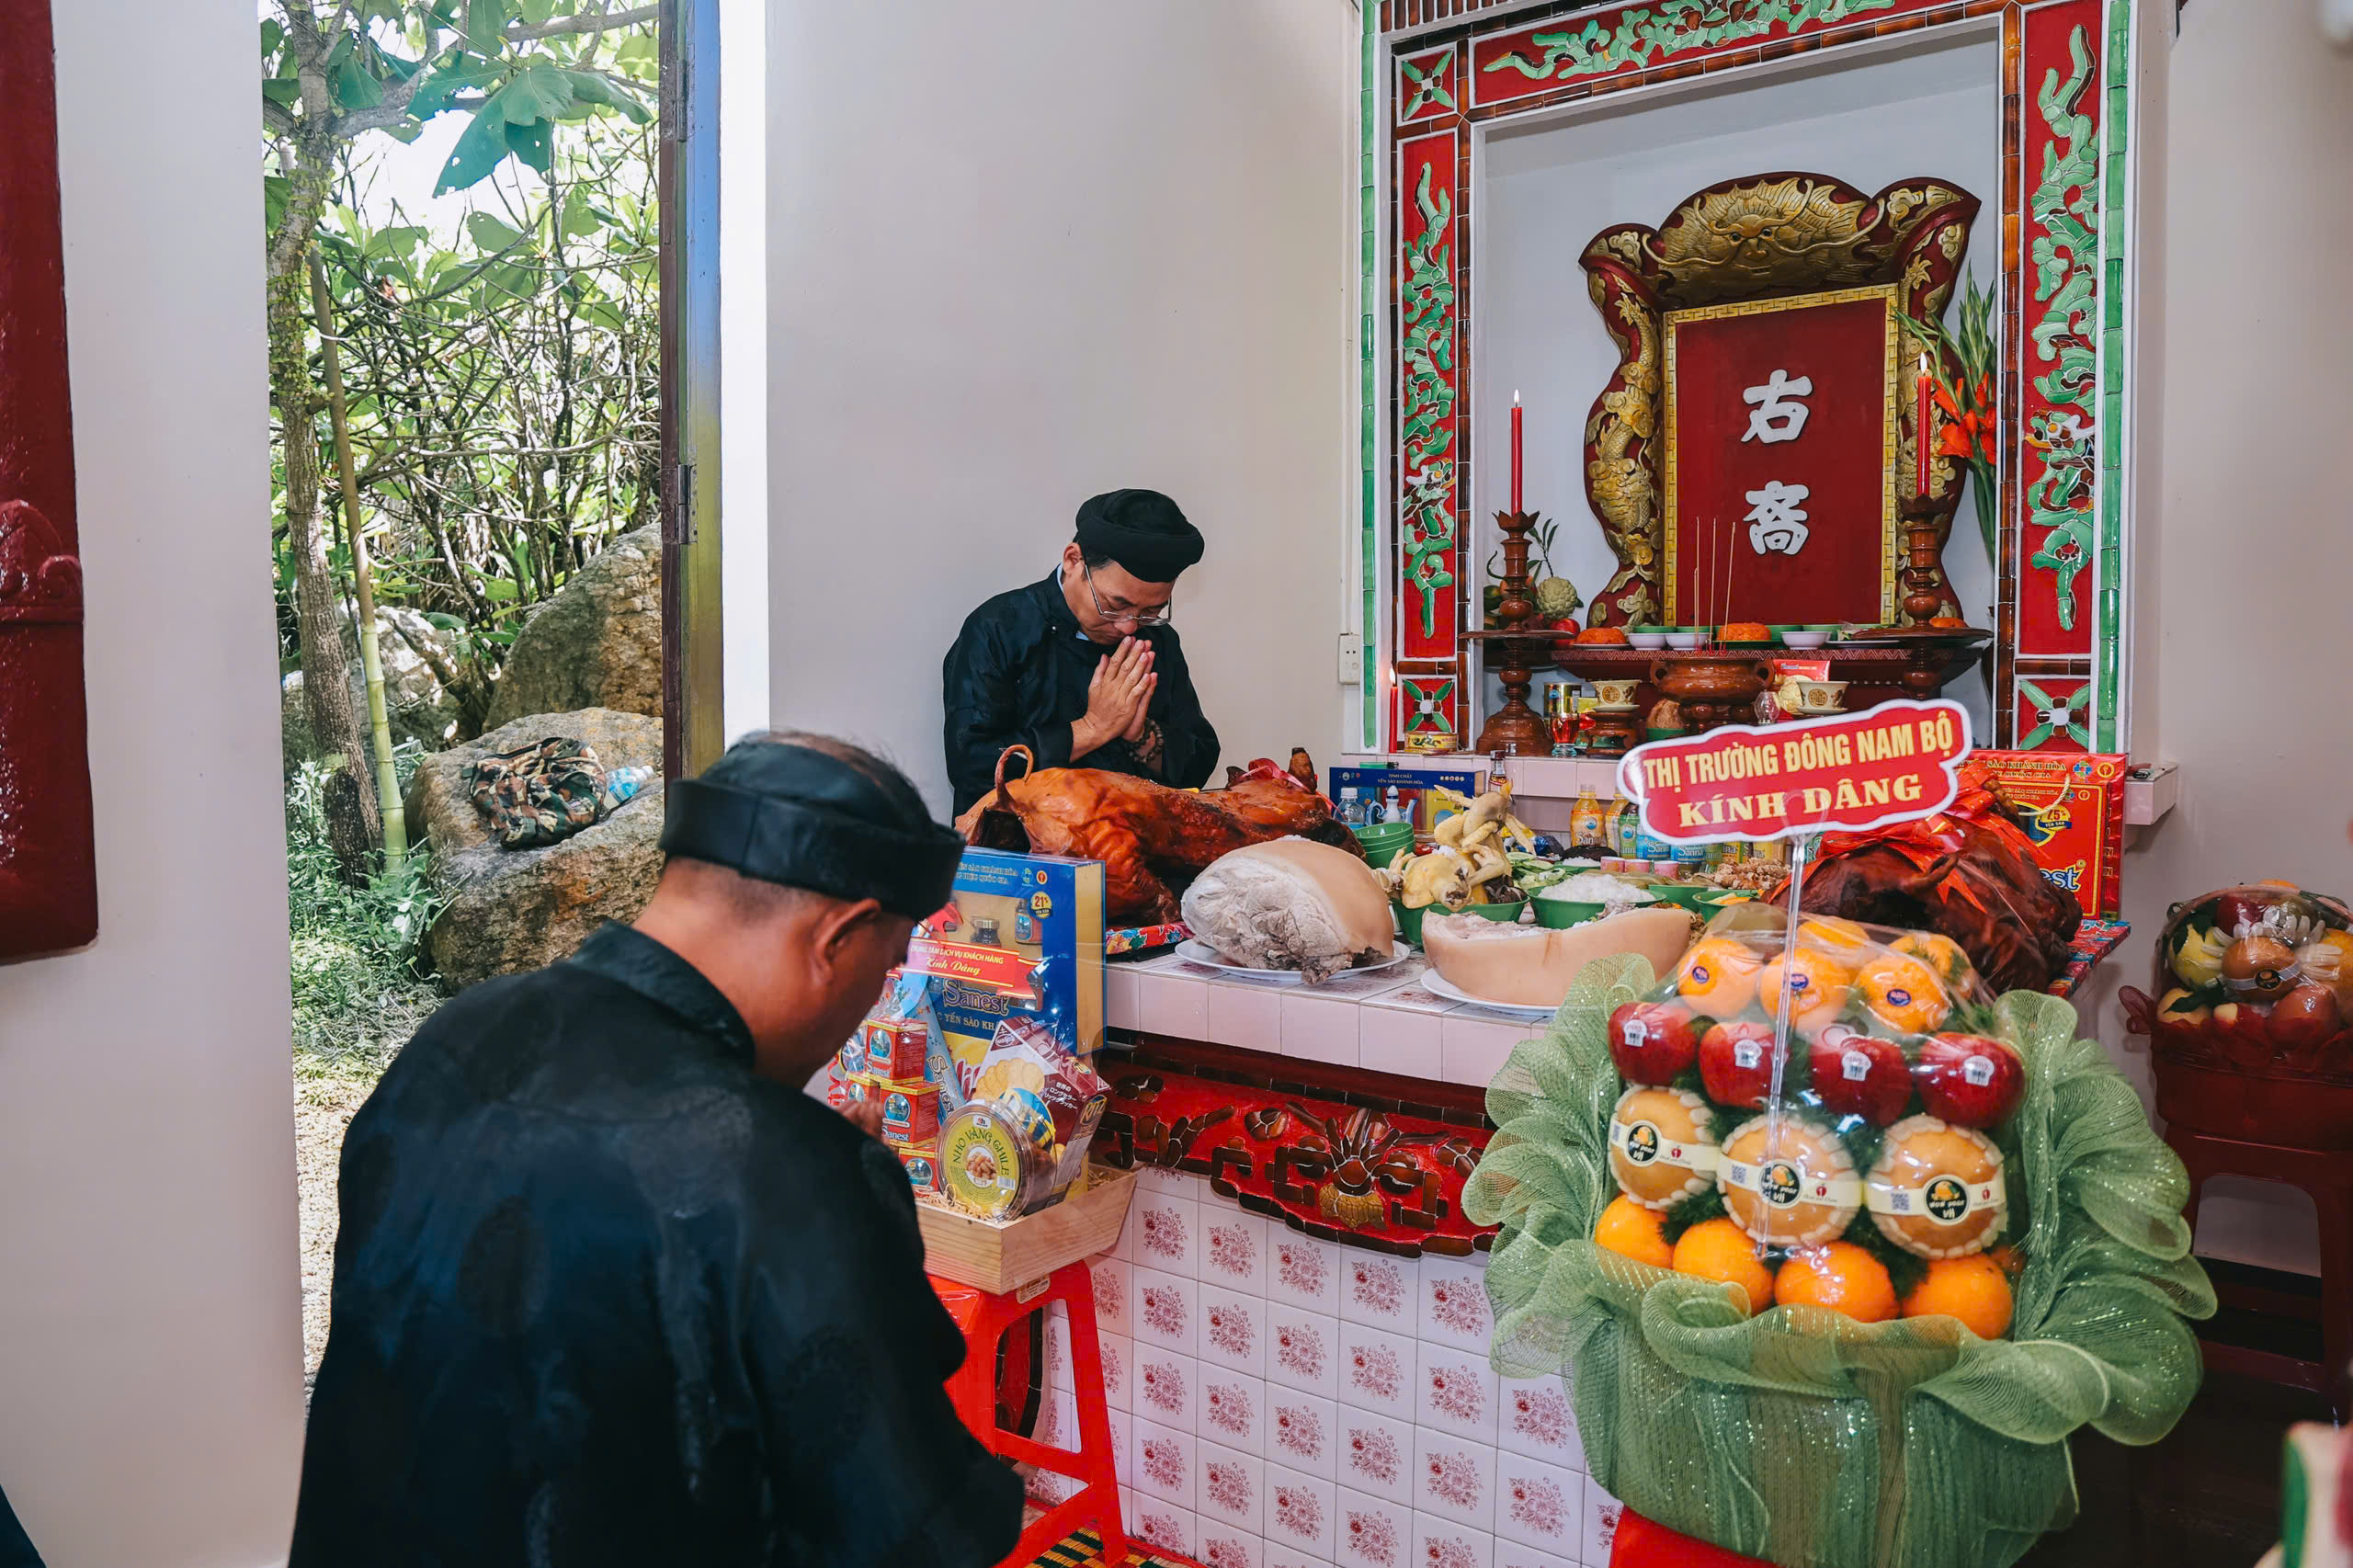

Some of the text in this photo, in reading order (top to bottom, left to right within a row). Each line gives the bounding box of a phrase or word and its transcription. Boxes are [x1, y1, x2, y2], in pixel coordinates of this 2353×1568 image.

[1643, 710, 1953, 792] THỊ TRƯỜNG ĐÔNG NAM BỘ
[1678, 773, 1923, 828] KÍNH DÂNG
[963, 949, 985, 962] KHÁCH
[985, 952, 1005, 964] HÀNG
[943, 978, 1009, 1017] Sanest
[945, 1012, 961, 1024] YẾN
[963, 1016, 980, 1028] SÀO
